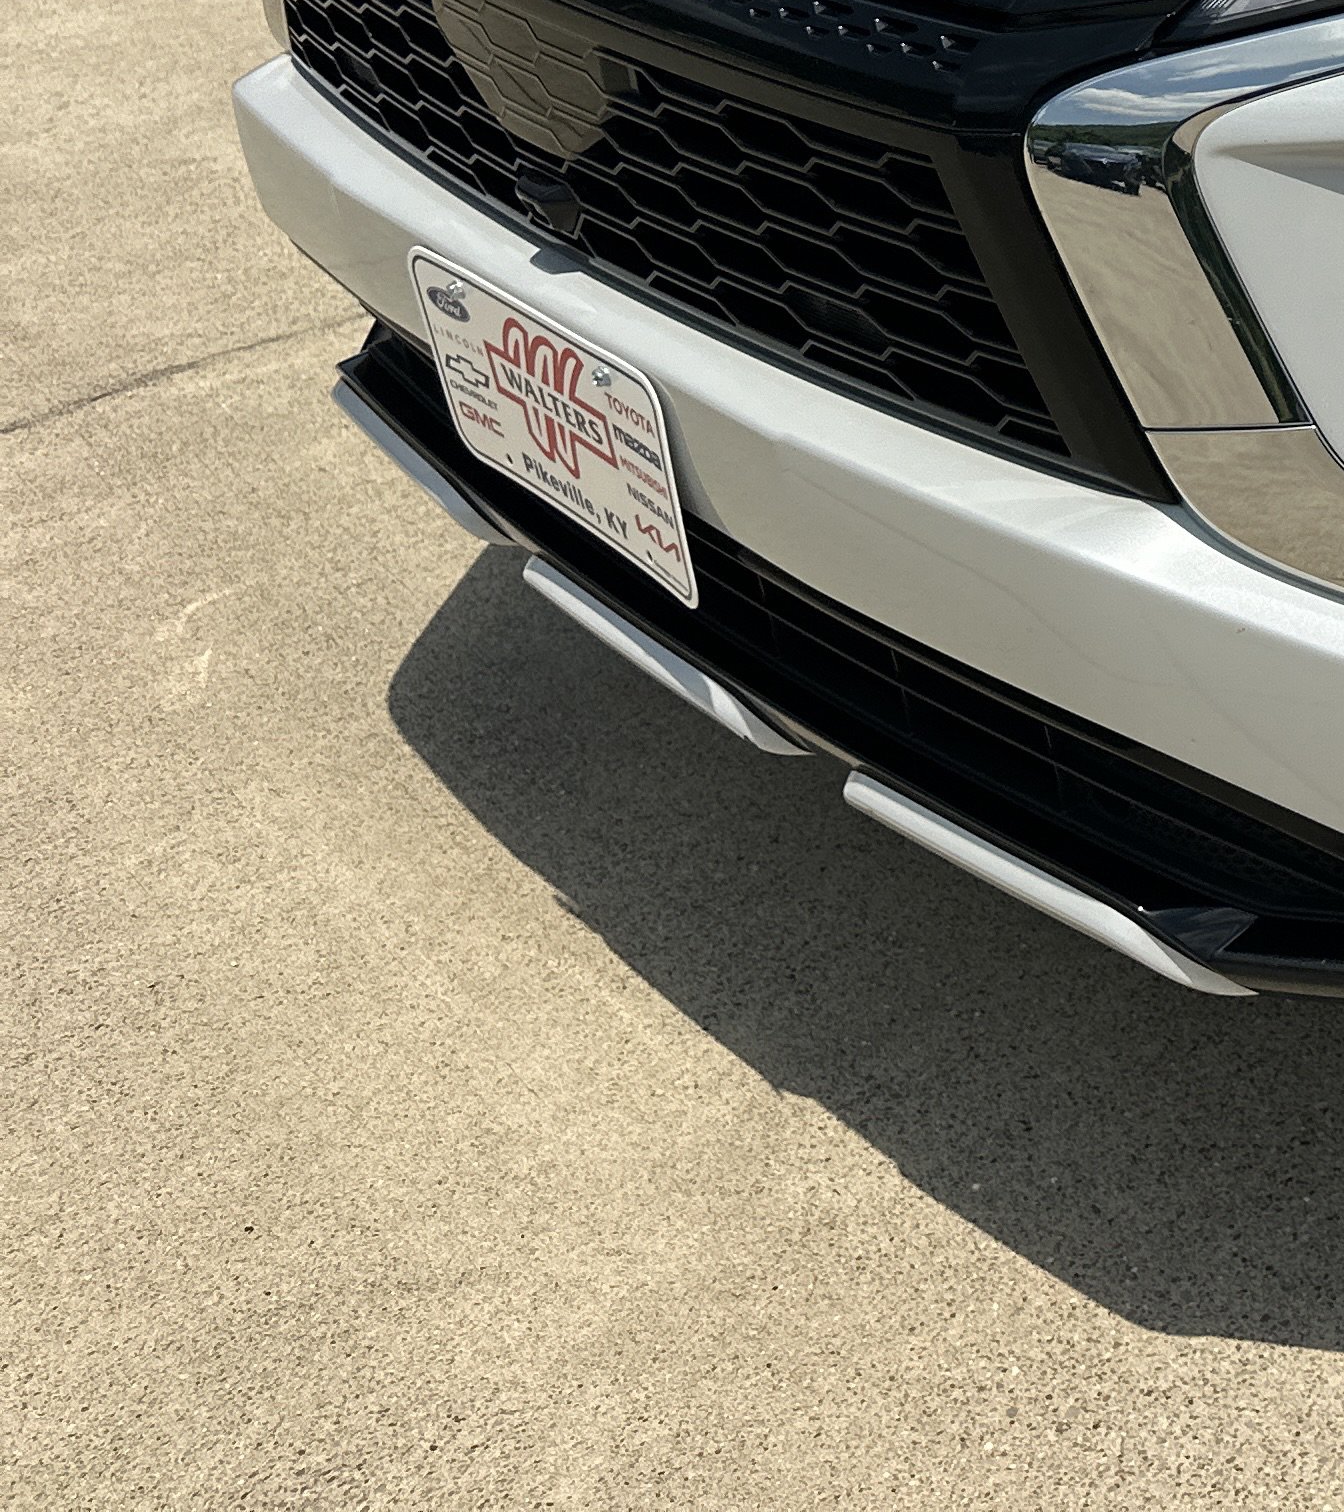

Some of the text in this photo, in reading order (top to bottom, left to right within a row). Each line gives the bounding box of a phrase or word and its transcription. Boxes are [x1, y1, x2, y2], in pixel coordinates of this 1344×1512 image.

[433, 323, 484, 357] LINCOLN
[459, 400, 505, 438] GMC
[500, 361, 603, 445] WALTERS
[604, 391, 656, 438] TOYOTA
[522, 451, 628, 539] Pikeville, KY
[626, 482, 675, 530] NISSAN
